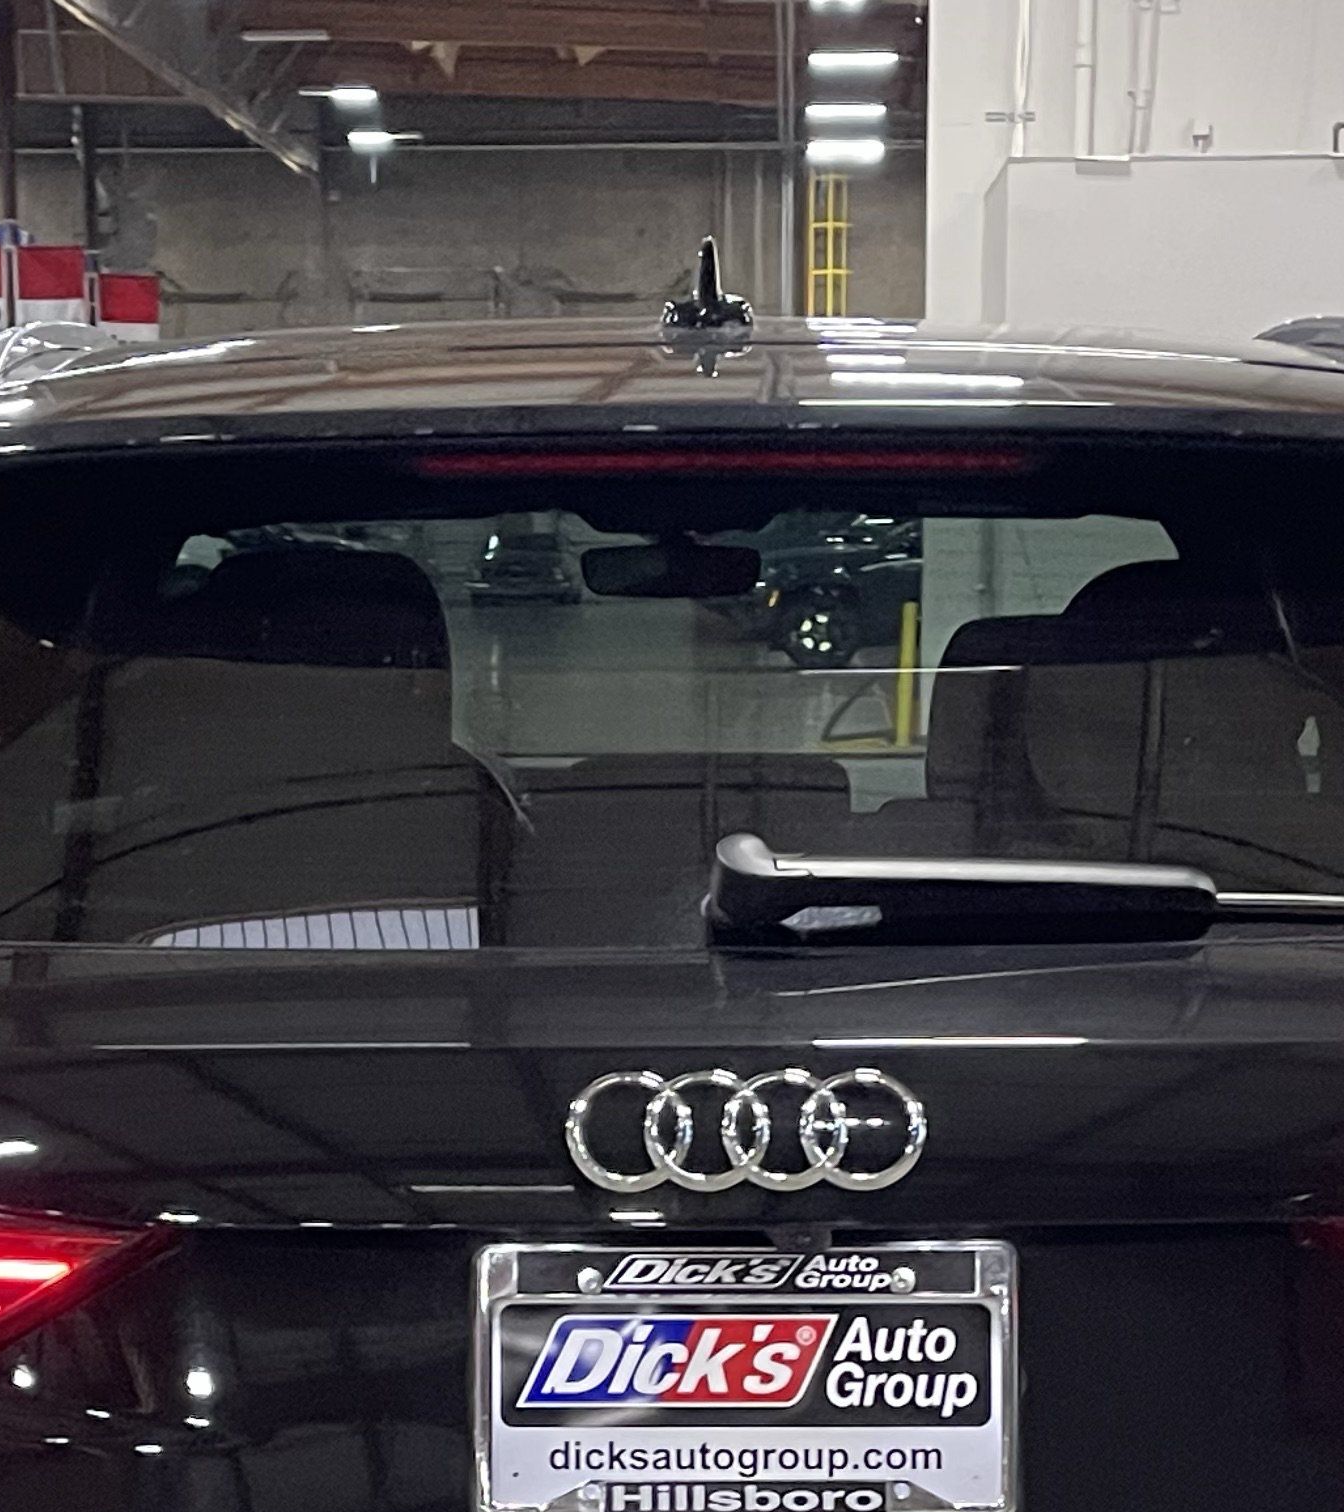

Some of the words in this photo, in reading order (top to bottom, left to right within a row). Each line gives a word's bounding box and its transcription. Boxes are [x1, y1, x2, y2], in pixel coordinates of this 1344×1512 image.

[618, 1258, 782, 1284] Dick's
[804, 1255, 878, 1272] Auto
[794, 1272, 892, 1291] Group
[833, 1316, 957, 1362] Auto
[541, 1322, 800, 1395] Dick's
[826, 1365, 978, 1418] Group
[550, 1441, 943, 1478] dicksautogroup.com
[610, 1485, 882, 1512] Hillsboro
